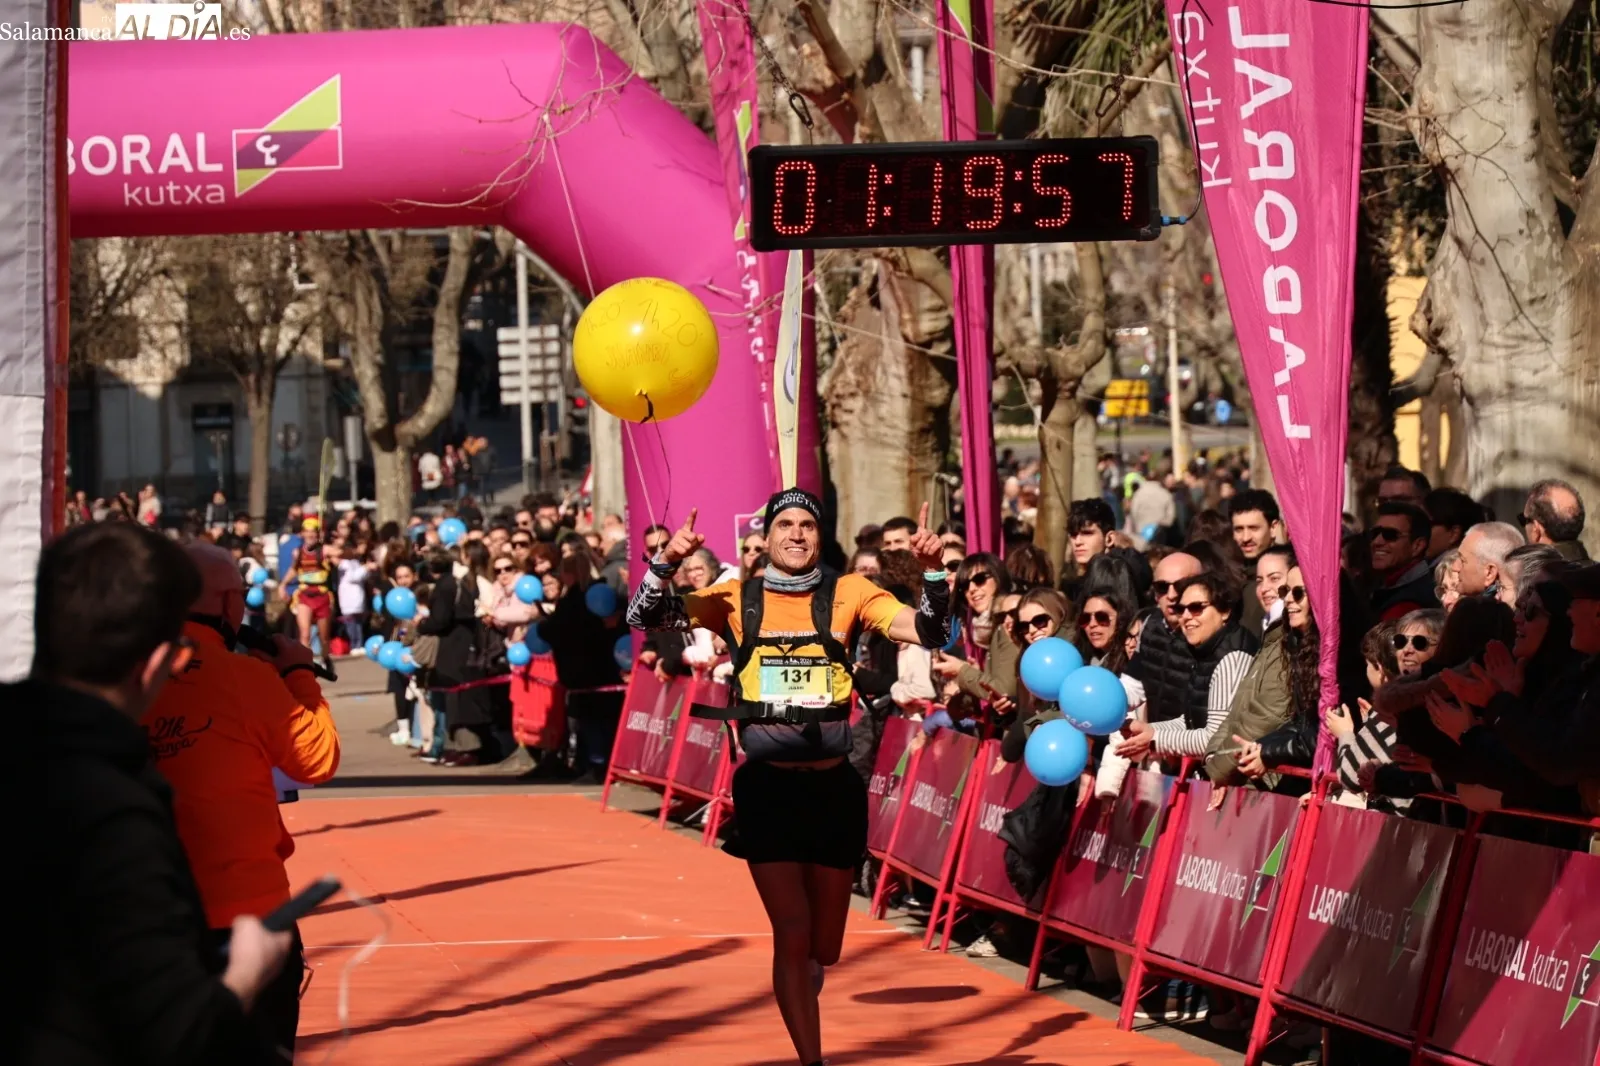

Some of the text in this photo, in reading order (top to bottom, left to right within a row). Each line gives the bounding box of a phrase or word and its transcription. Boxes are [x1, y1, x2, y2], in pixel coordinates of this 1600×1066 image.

[67, 133, 223, 176] ORAL
[124, 181, 225, 206] kutxa
[780, 669, 811, 683] 131
[1176, 853, 1222, 894] LABORAL
[1308, 884, 1394, 940] LABORAL kutxa
[1464, 927, 1570, 991] LABORAL kutxa
